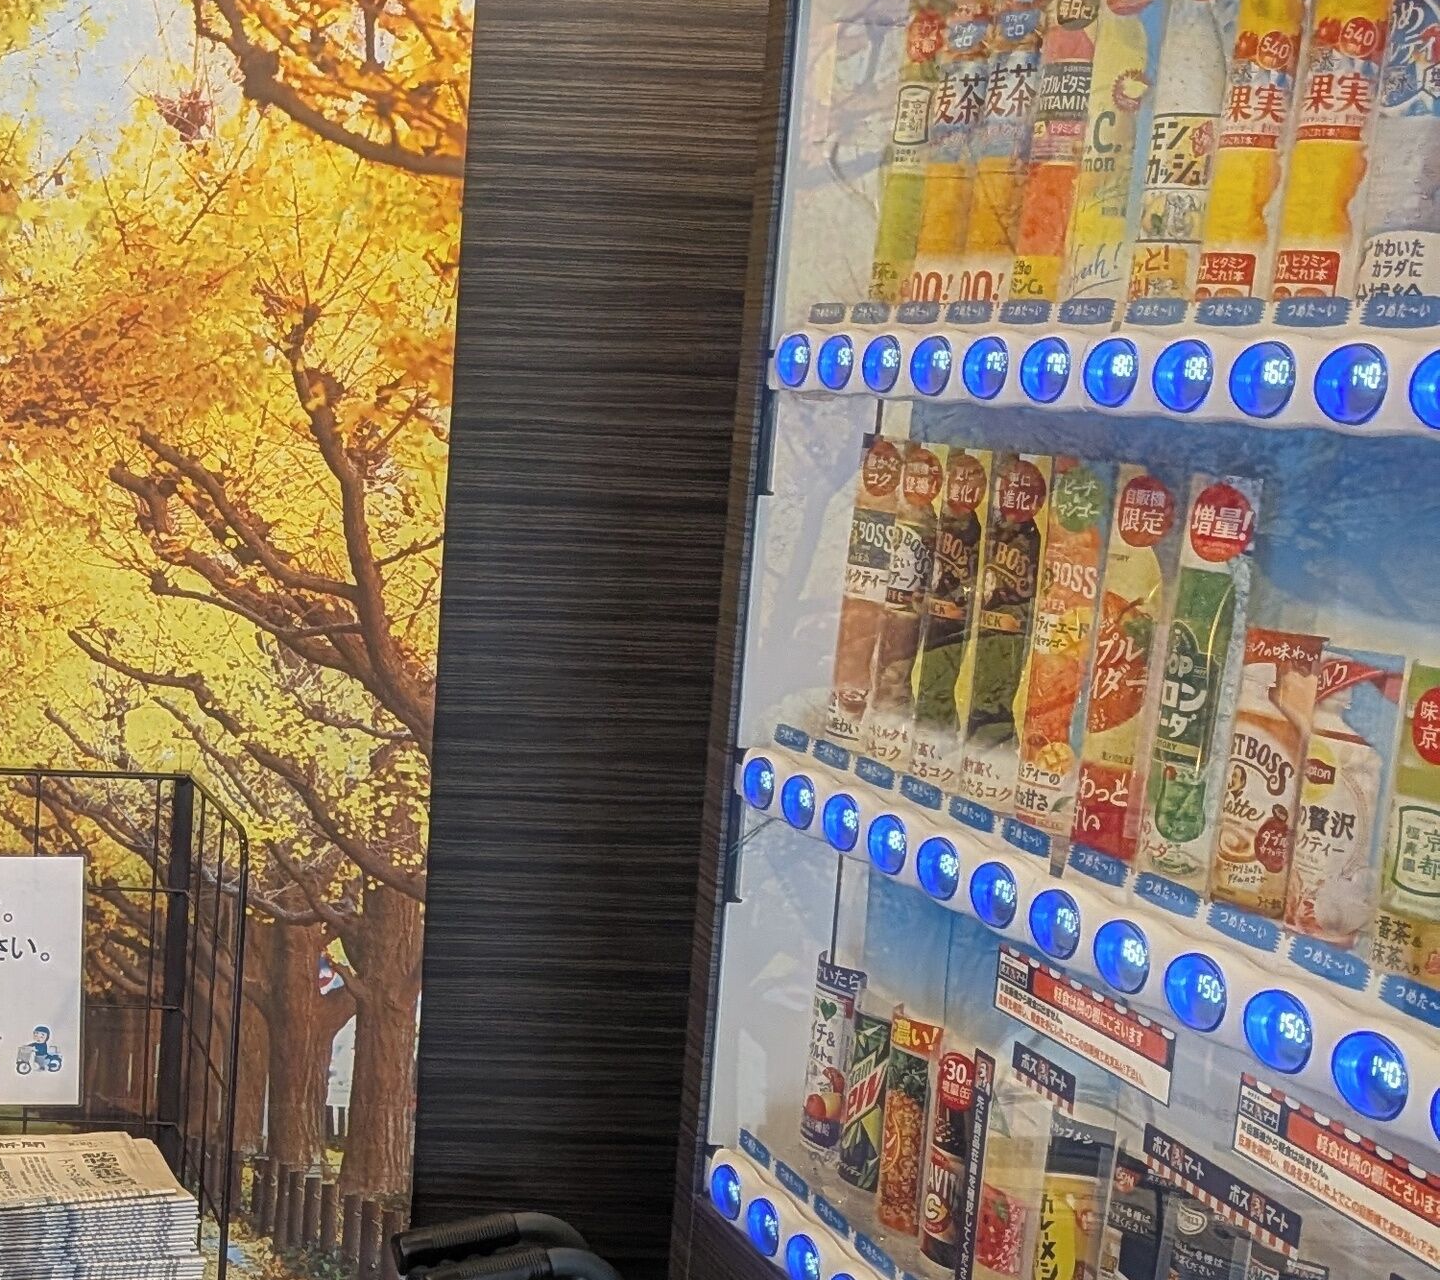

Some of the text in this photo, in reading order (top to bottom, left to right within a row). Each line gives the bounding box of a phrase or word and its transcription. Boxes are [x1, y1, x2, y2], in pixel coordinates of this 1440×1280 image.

[1260, 35, 1290, 61] 540
[1342, 23, 1375, 49] 540
[933, 72, 987, 126] 麦茶
[985, 62, 1038, 119] 麦茶
[1228, 82, 1287, 125] 果実
[1303, 70, 1372, 114] 果実
[1152, 120, 1191, 151] モン
[1373, 238, 1425, 258] かわいた
[1211, 256, 1248, 270] ビタミン
[1291, 256, 1332, 269] ビタミン
[1372, 260, 1424, 278] カラダに
[1207, 304, 1253, 318] つめた〜い
[1286, 303, 1337, 319] つめた〜い
[1375, 303, 1432, 319] つめた〜い
[1111, 353, 1134, 377] 180
[1183, 356, 1208, 381] 180
[1263, 358, 1290, 385] 160
[1351, 361, 1381, 389] 140
[866, 473, 892, 488] コク
[1009, 472, 1032, 488] 更に
[948, 485, 981, 504] 進化!
[1001, 489, 1039, 511] 進化!
[1124, 488, 1167, 507] 自販機
[1058, 503, 1102, 518] マンゴー
[1120, 506, 1164, 536] 限定
[1191, 502, 1254, 542] 増量!
[859, 520, 896, 554] BOSS
[1052, 560, 1098, 600] BOSS
[1161, 678, 1208, 713] ロン
[1419, 700, 1440, 721] 味
[1418, 725, 1440, 751] 京
[1247, 736, 1295, 797] BOSS
[1077, 851, 1118, 877] つめた〜い
[1144, 879, 1189, 906] つめた〜い
[1055, 907, 1078, 934] 170
[1219, 910, 1268, 938] つめた〜い
[1121, 938, 1147, 968] 160
[1302, 945, 1357, 977] つめた〜い
[1196, 973, 1223, 1005] 150
[1052, 986, 1144, 1048] 軽食は隣の棚にございます
[1278, 1011, 1308, 1045] 150
[893, 1017, 938, 1050] 濃い!
[1370, 1055, 1402, 1090] 140
[1152, 1135, 1205, 1180] ボスマート
[1228, 1183, 1289, 1234] ボスマート
